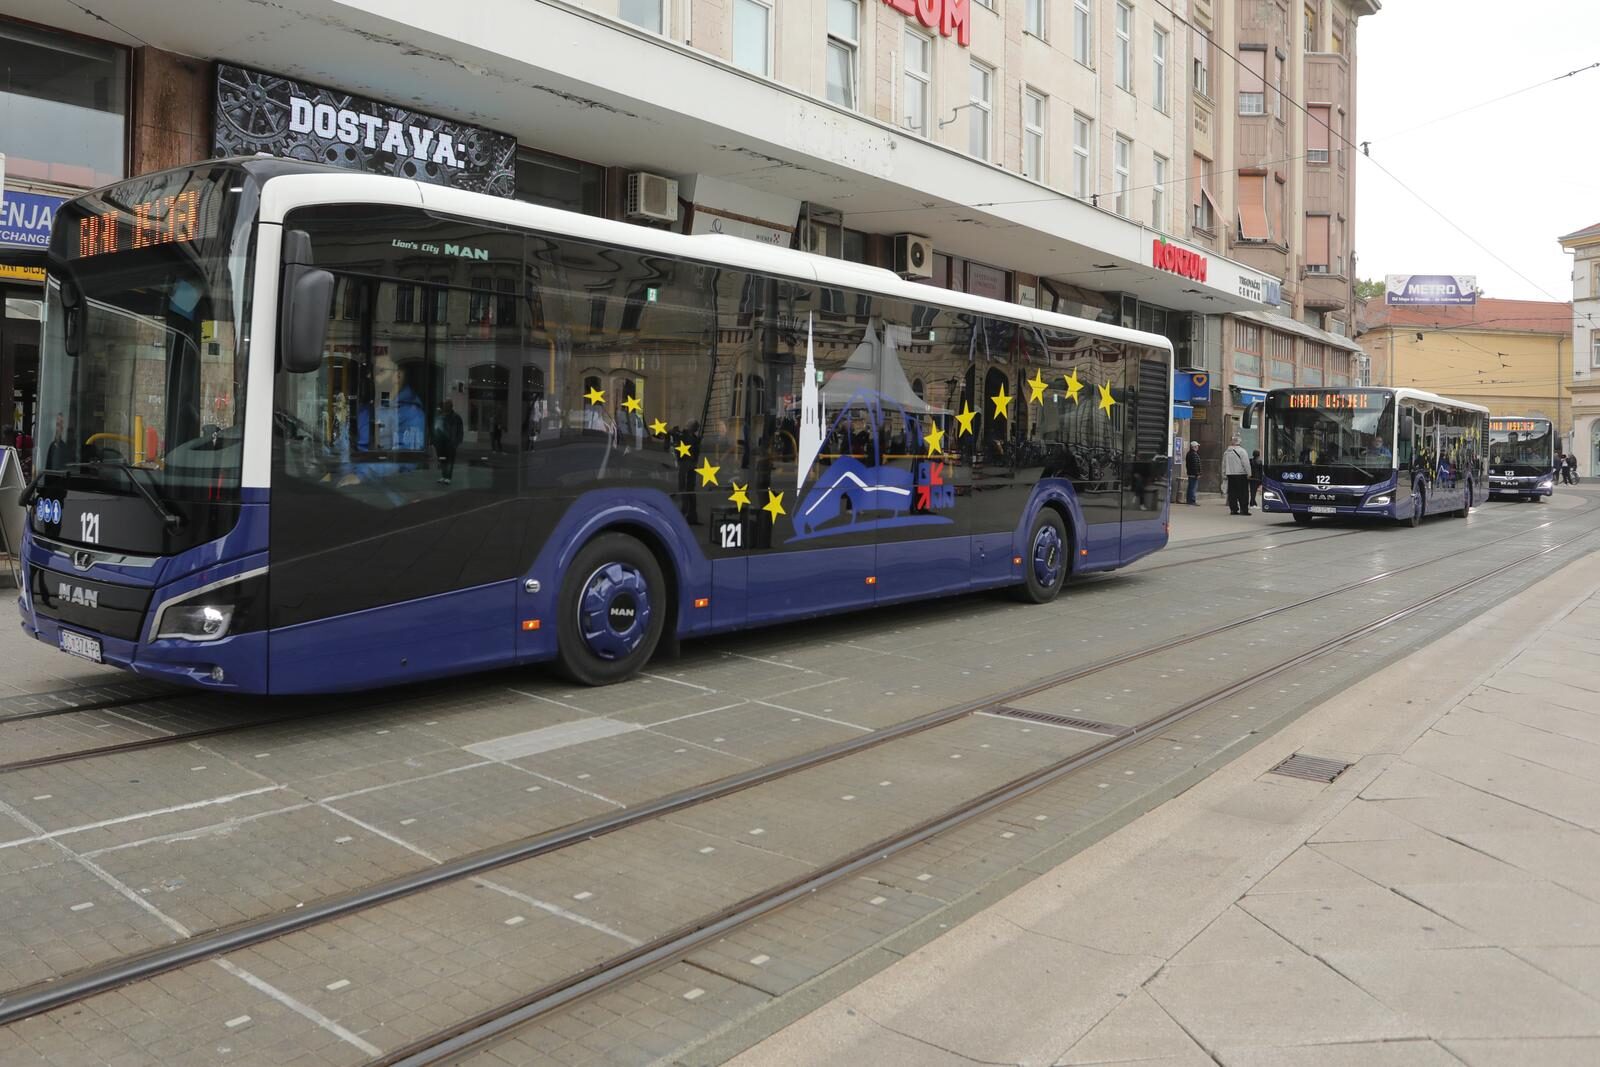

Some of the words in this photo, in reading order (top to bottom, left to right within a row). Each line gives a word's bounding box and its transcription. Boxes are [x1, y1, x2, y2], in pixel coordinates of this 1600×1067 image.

[289, 96, 465, 169] DOSTAVA:
[392, 239, 418, 250] Lion's
[421, 243, 440, 255] City
[444, 243, 489, 260] MAN
[1153, 239, 1207, 282] KONZUM
[1239, 288, 1260, 300] CENTAR
[1408, 284, 1456, 294] METRO
[1317, 476, 1330, 484] 122
[80, 512, 100, 544] 121
[720, 523, 742, 548] 121
[58, 582, 99, 609] MAN
[611, 608, 634, 616] MAN
